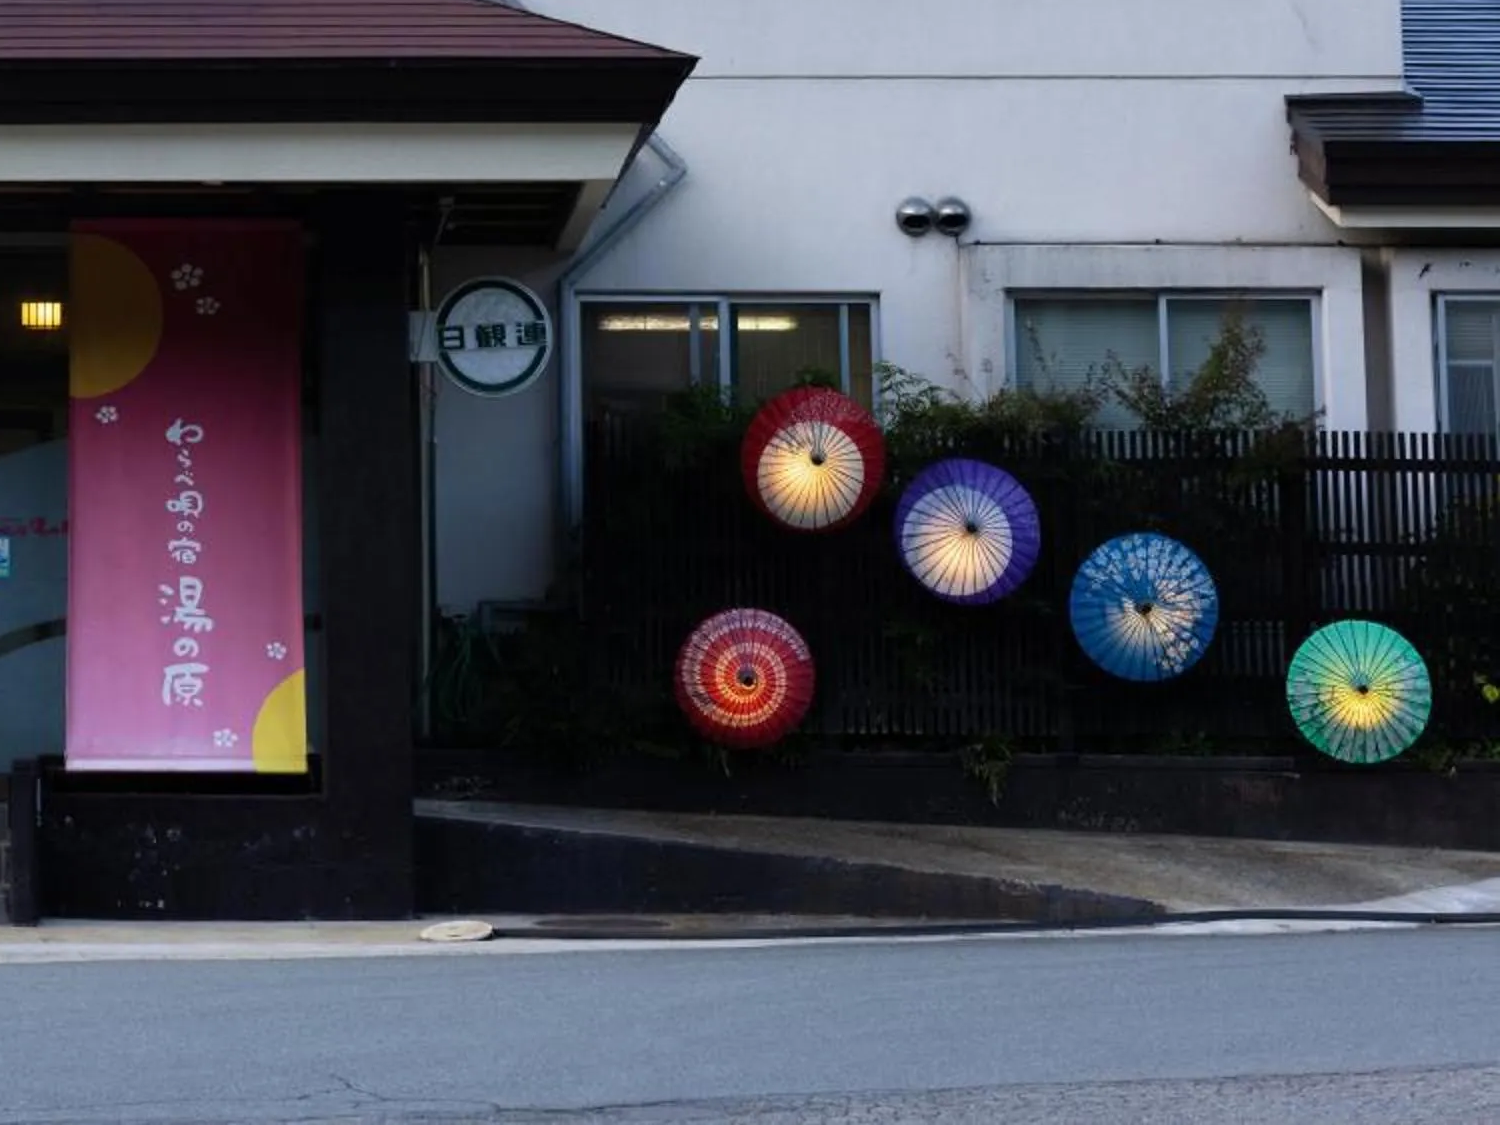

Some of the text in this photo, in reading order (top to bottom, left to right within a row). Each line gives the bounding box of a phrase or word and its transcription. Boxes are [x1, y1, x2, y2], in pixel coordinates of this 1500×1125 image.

[439, 322, 547, 350] 日観連
[159, 577, 214, 707] 湯の原
